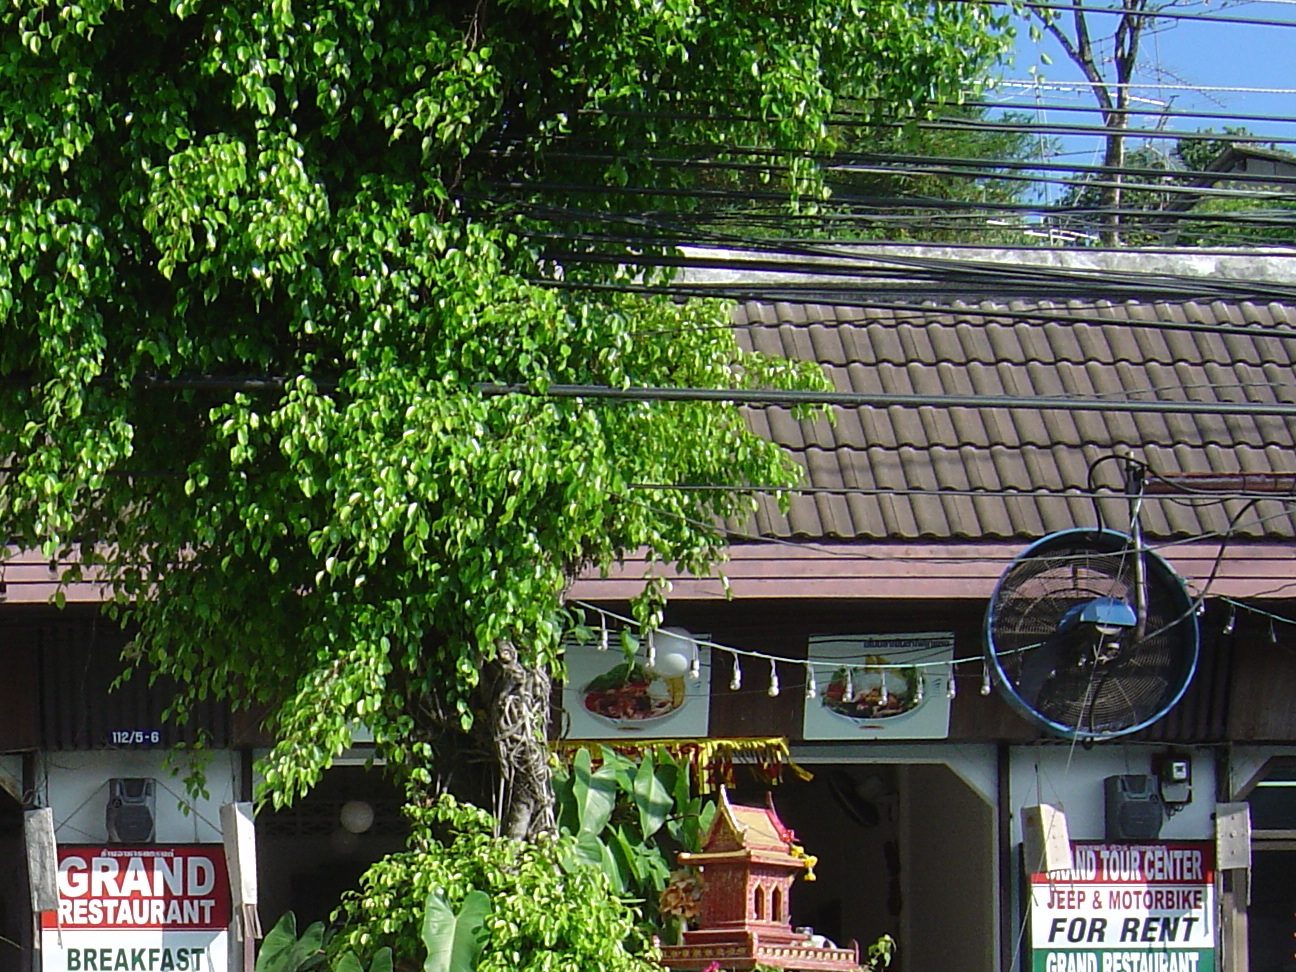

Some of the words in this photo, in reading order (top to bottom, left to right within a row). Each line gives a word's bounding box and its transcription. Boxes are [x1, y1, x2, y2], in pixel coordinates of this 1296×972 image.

[58, 856, 216, 897] GRAND
[1101, 850, 1142, 881] TOUR
[1144, 850, 1202, 881] CENTER
[59, 899, 216, 924] RESTAURANT
[1047, 890, 1086, 909] JEEP
[1092, 891, 1103, 909] &
[1109, 890, 1203, 909] MOTORBIKE
[1048, 917, 1107, 943] FOR
[1120, 917, 1199, 943] RENT
[67, 948, 205, 971] BREAKFAST
